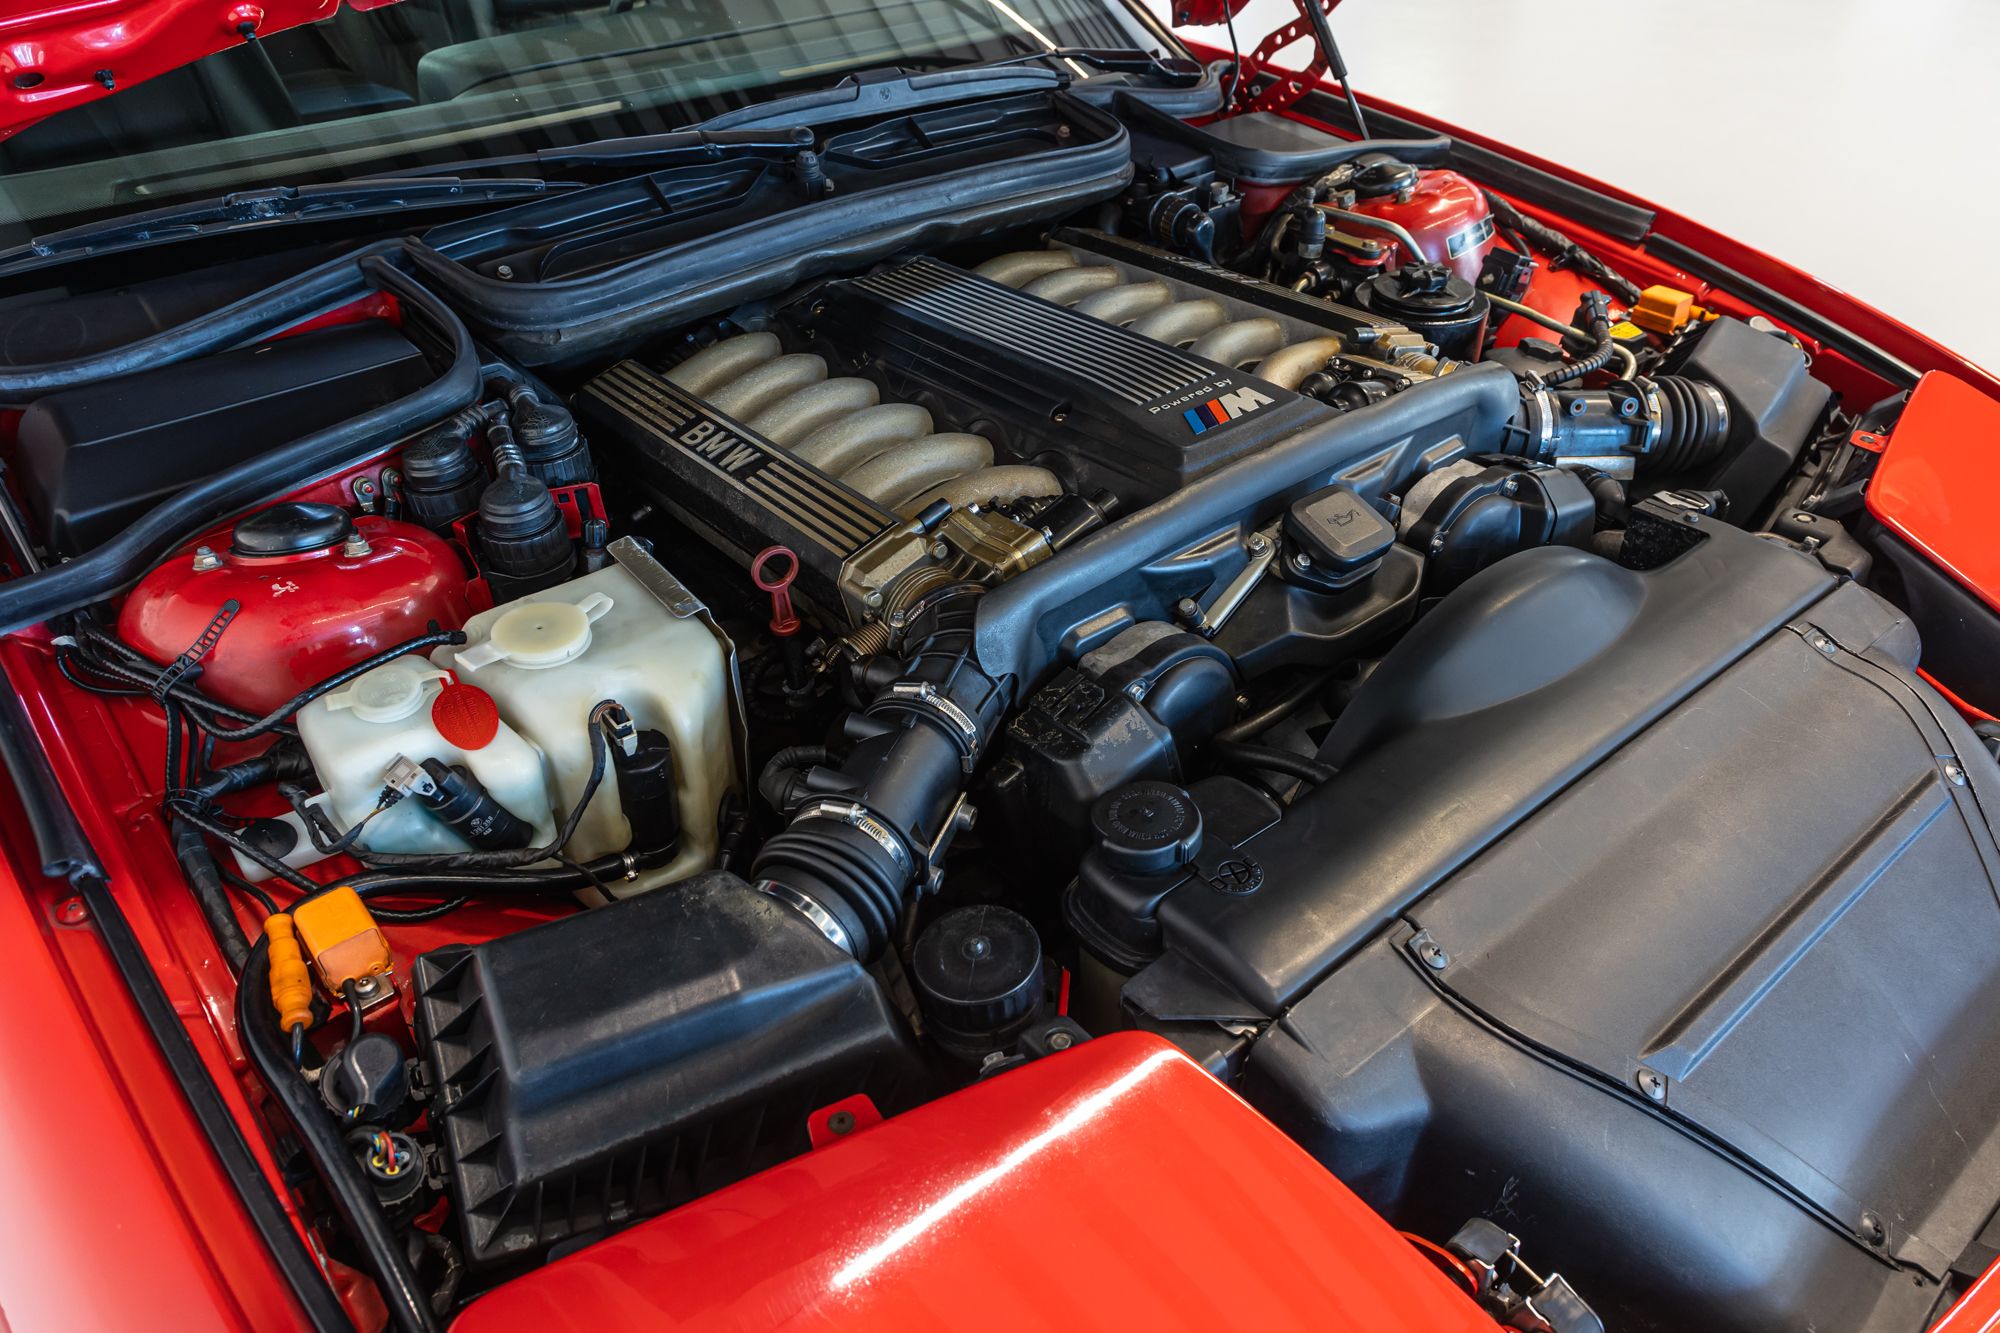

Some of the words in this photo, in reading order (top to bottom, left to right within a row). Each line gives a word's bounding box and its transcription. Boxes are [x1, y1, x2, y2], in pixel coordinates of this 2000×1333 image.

[1149, 386, 1213, 415] Powered
[1213, 378, 1233, 389] by
[1218, 386, 1276, 420] M
[678, 420, 764, 473] BMW
